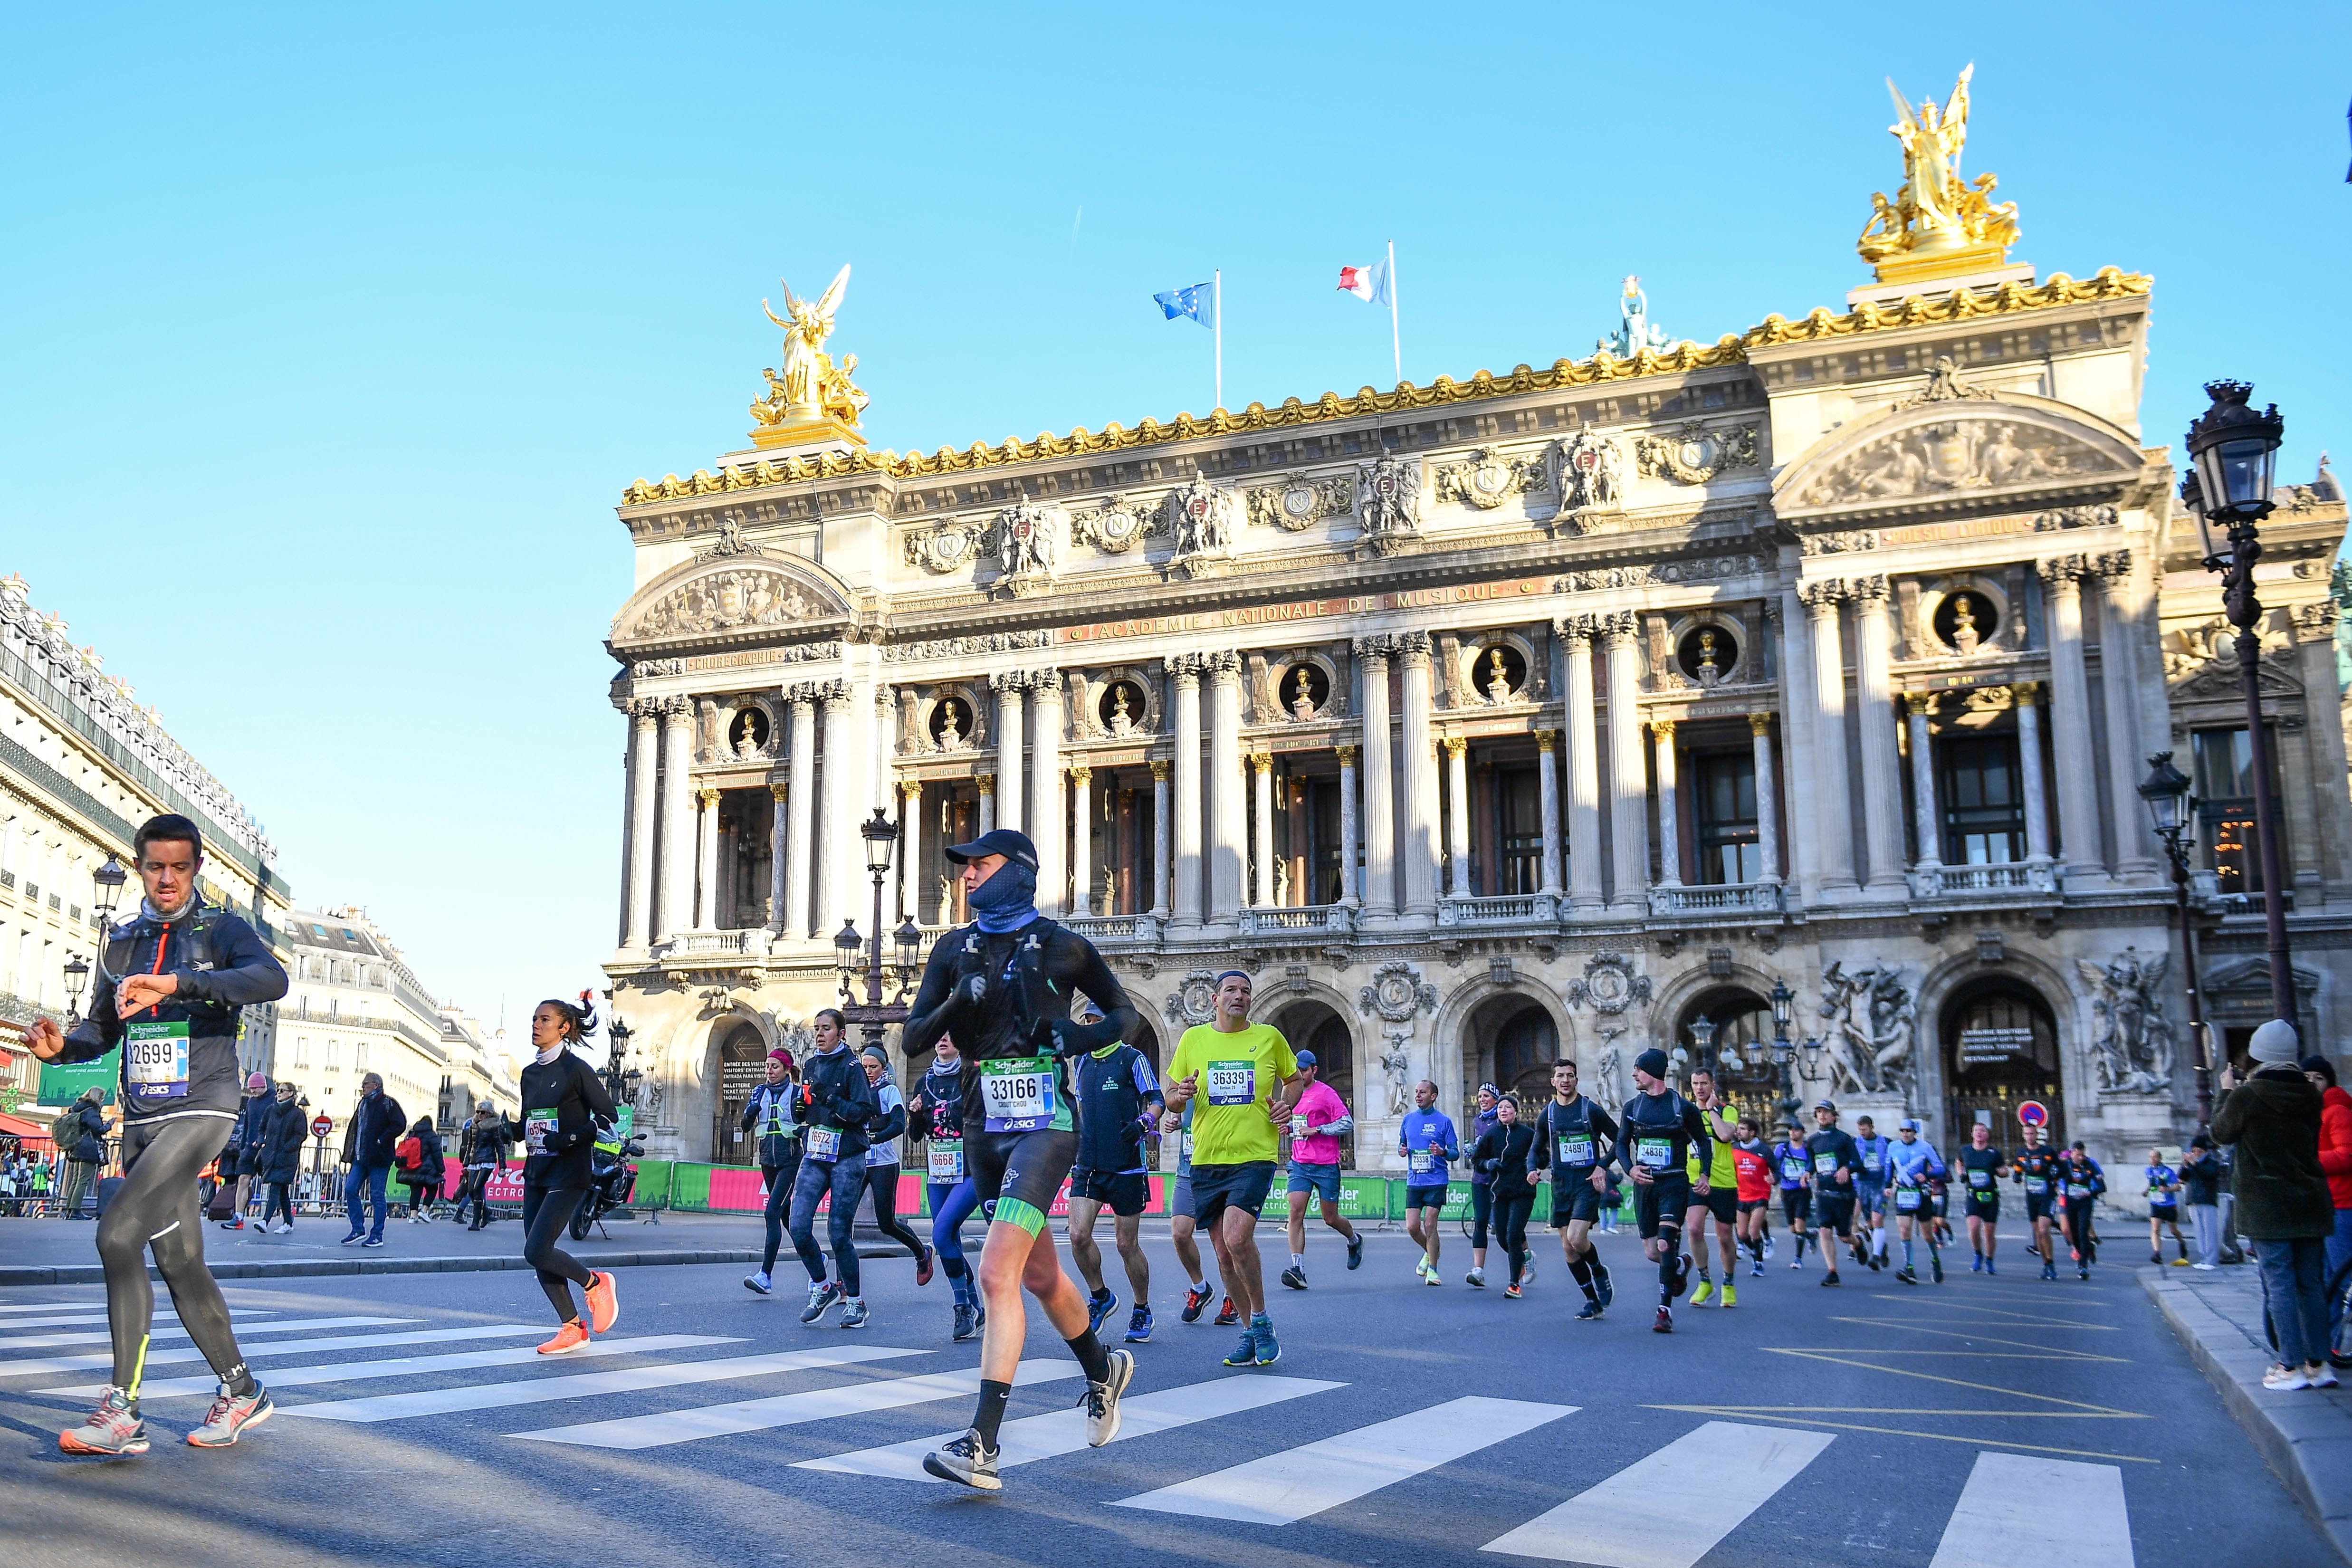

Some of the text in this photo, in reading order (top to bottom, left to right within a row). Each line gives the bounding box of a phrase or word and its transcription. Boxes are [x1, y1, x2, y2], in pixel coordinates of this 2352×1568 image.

[1582, 455, 1590, 467] E
[1483, 472, 1494, 486] N
[1380, 480, 1389, 492] E
[1194, 502, 1202, 514] E
[1291, 496, 1302, 508] N
[1112, 518, 1122, 530] N
[1019, 525, 1027, 536] E
[1892, 526, 1947, 544] POESIE
[944, 539, 953, 552] N
[1098, 583, 1502, 639] ACADEMIE NATIONALE DE MUSIQUE
[695, 651, 776, 669] CHOREGRAPHIE
[130, 1025, 170, 1034] Schneider
[995, 1060, 1035, 1069] Schneider
[1213, 1072, 1244, 1085] 36339
[991, 1078, 1036, 1100] 33166
[1013, 1119, 1036, 1128] asics
[812, 1131, 831, 1144] 16672
[1564, 1144, 1585, 1154] 24897
[1642, 1147, 1664, 1157] 24836
[931, 1154, 954, 1166] 16668
